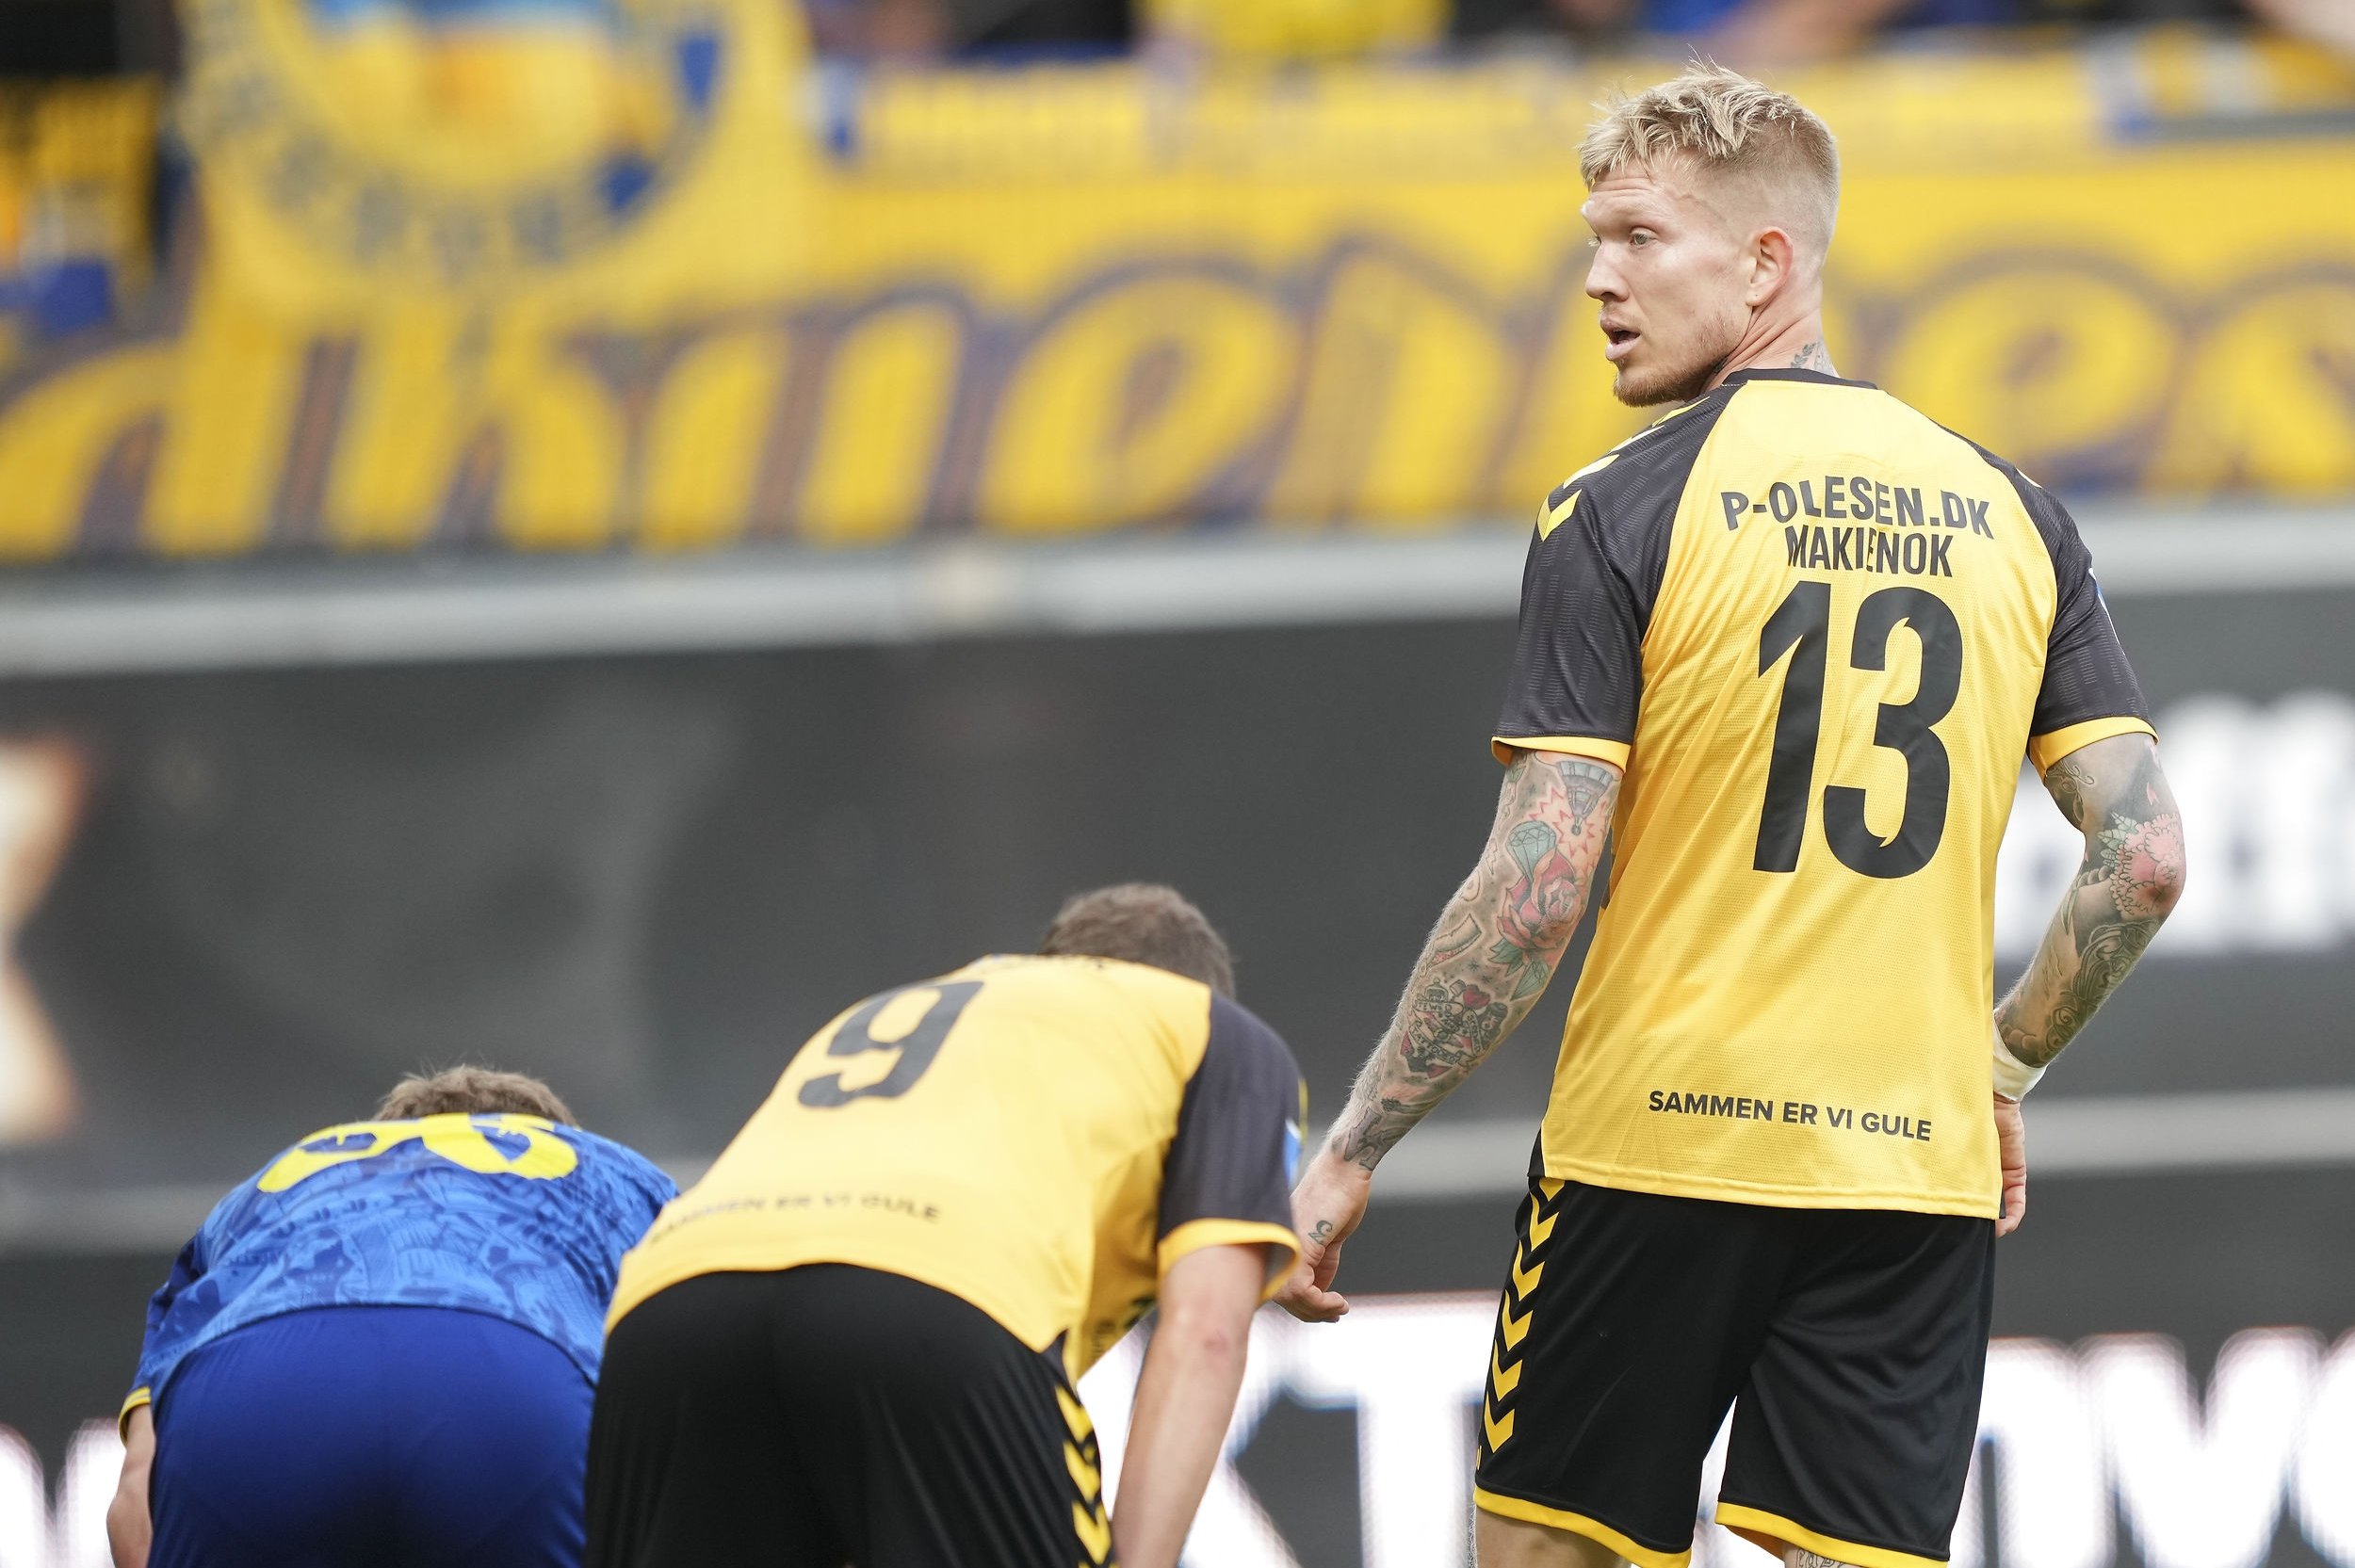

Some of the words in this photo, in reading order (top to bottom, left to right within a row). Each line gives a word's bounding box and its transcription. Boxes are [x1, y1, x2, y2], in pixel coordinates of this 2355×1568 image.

[1721, 476, 1995, 540] P-OLESEN.DK
[1785, 525, 1954, 578] MAKIENOK
[1753, 580, 1963, 880] 13
[797, 980, 985, 1109] 9
[1648, 1090, 1774, 1122] SAMMEN
[1782, 1102, 1818, 1125] ER
[1827, 1106, 1853, 1130] VI
[1860, 1112, 1932, 1142] GULE
[858, 1191, 943, 1224] GULE
